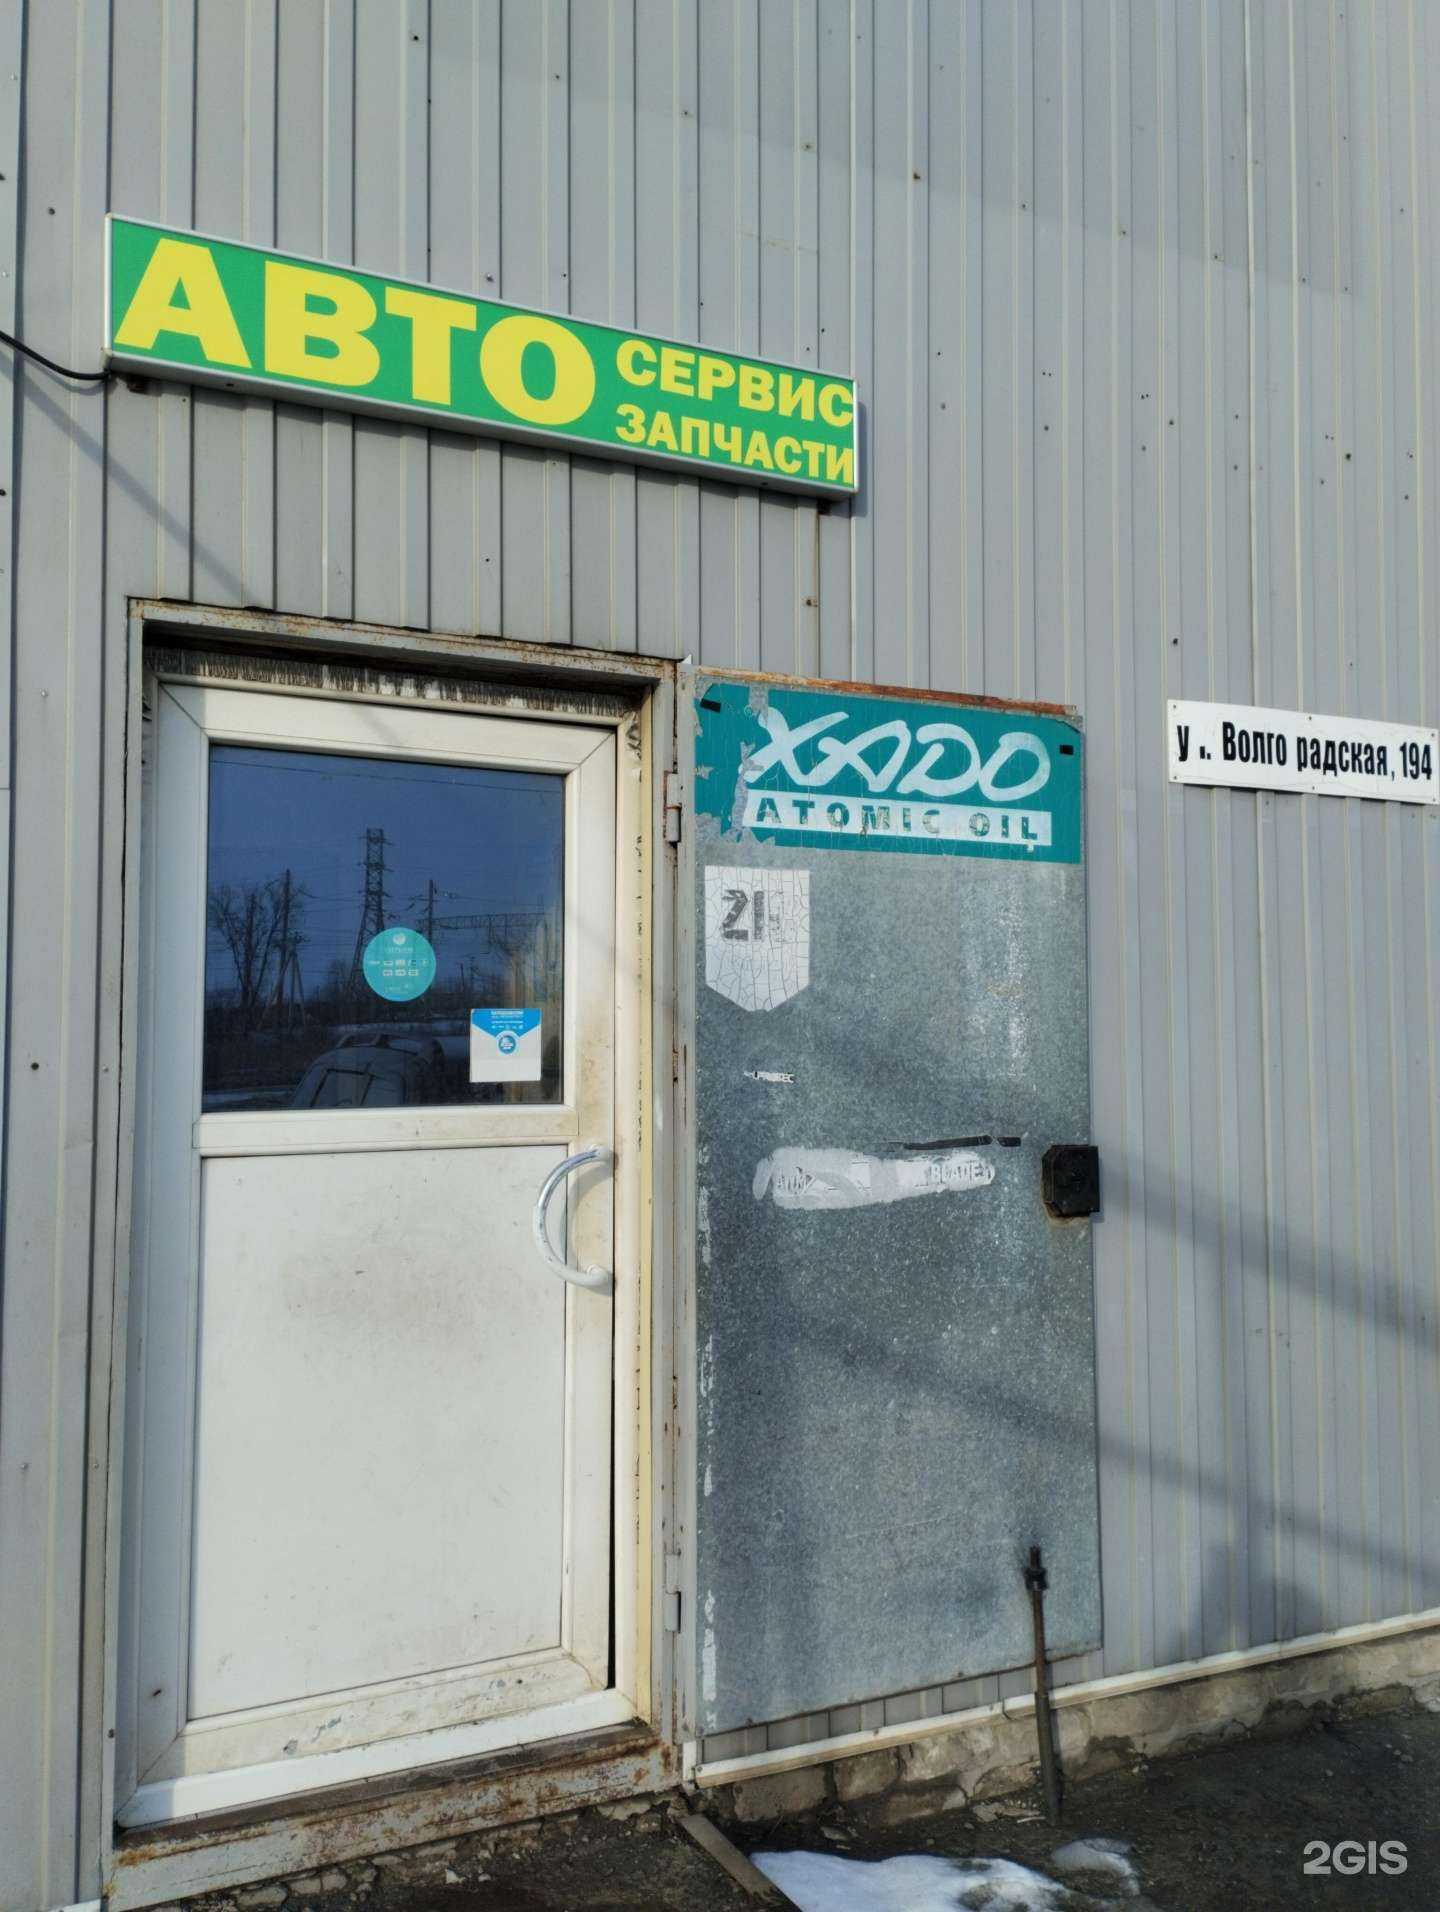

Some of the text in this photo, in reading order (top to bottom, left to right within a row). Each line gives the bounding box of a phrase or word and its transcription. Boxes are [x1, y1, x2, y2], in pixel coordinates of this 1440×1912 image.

[113, 238, 597, 427] АВТО
[615, 339, 854, 428] СЕРВИС
[615, 403, 855, 485] ЗАПЧАСТИ
[741, 706, 1052, 803] XADO
[755, 796, 1039, 841] ATOMIC OIL
